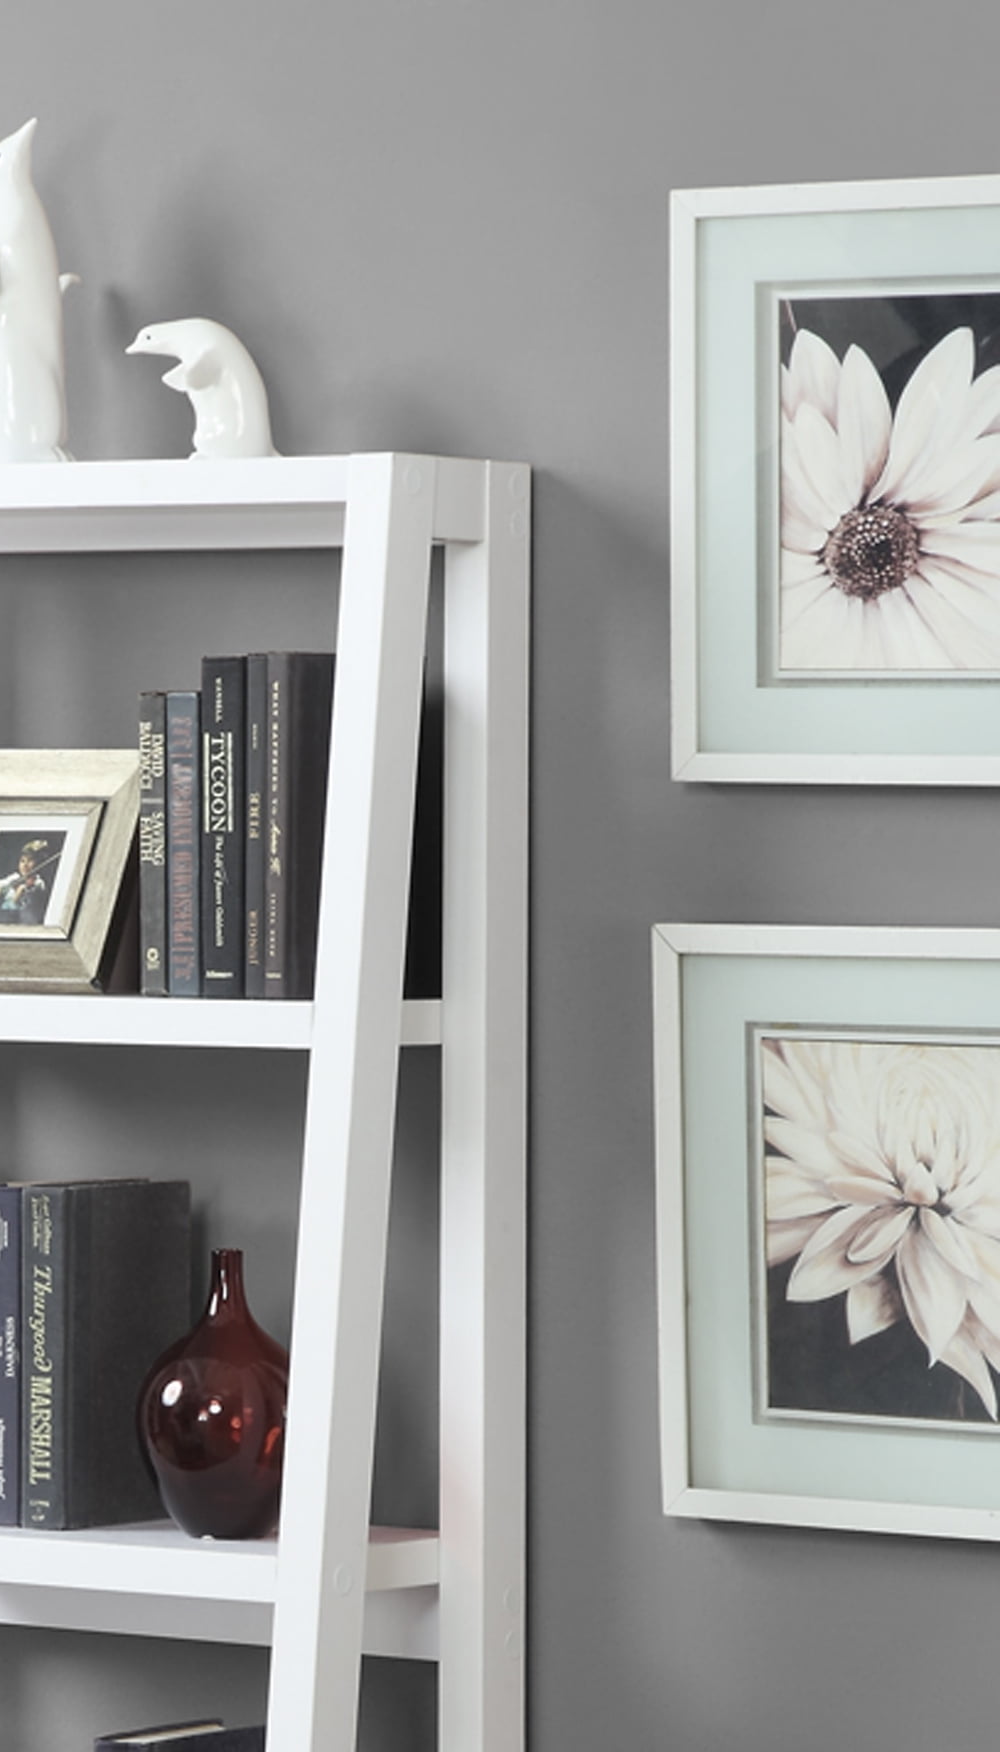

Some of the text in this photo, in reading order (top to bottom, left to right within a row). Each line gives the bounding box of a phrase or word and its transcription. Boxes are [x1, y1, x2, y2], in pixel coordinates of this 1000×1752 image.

[139, 721, 152, 789] BALDACCI
[152, 734, 164, 778] DAVID
[210, 732, 226, 831] TYCOON
[140, 817, 152, 862] FAITH
[152, 811, 165, 866] SAVING
[29, 1264, 53, 1373] Thurgood
[28, 1376, 52, 1485] MARSHALL
